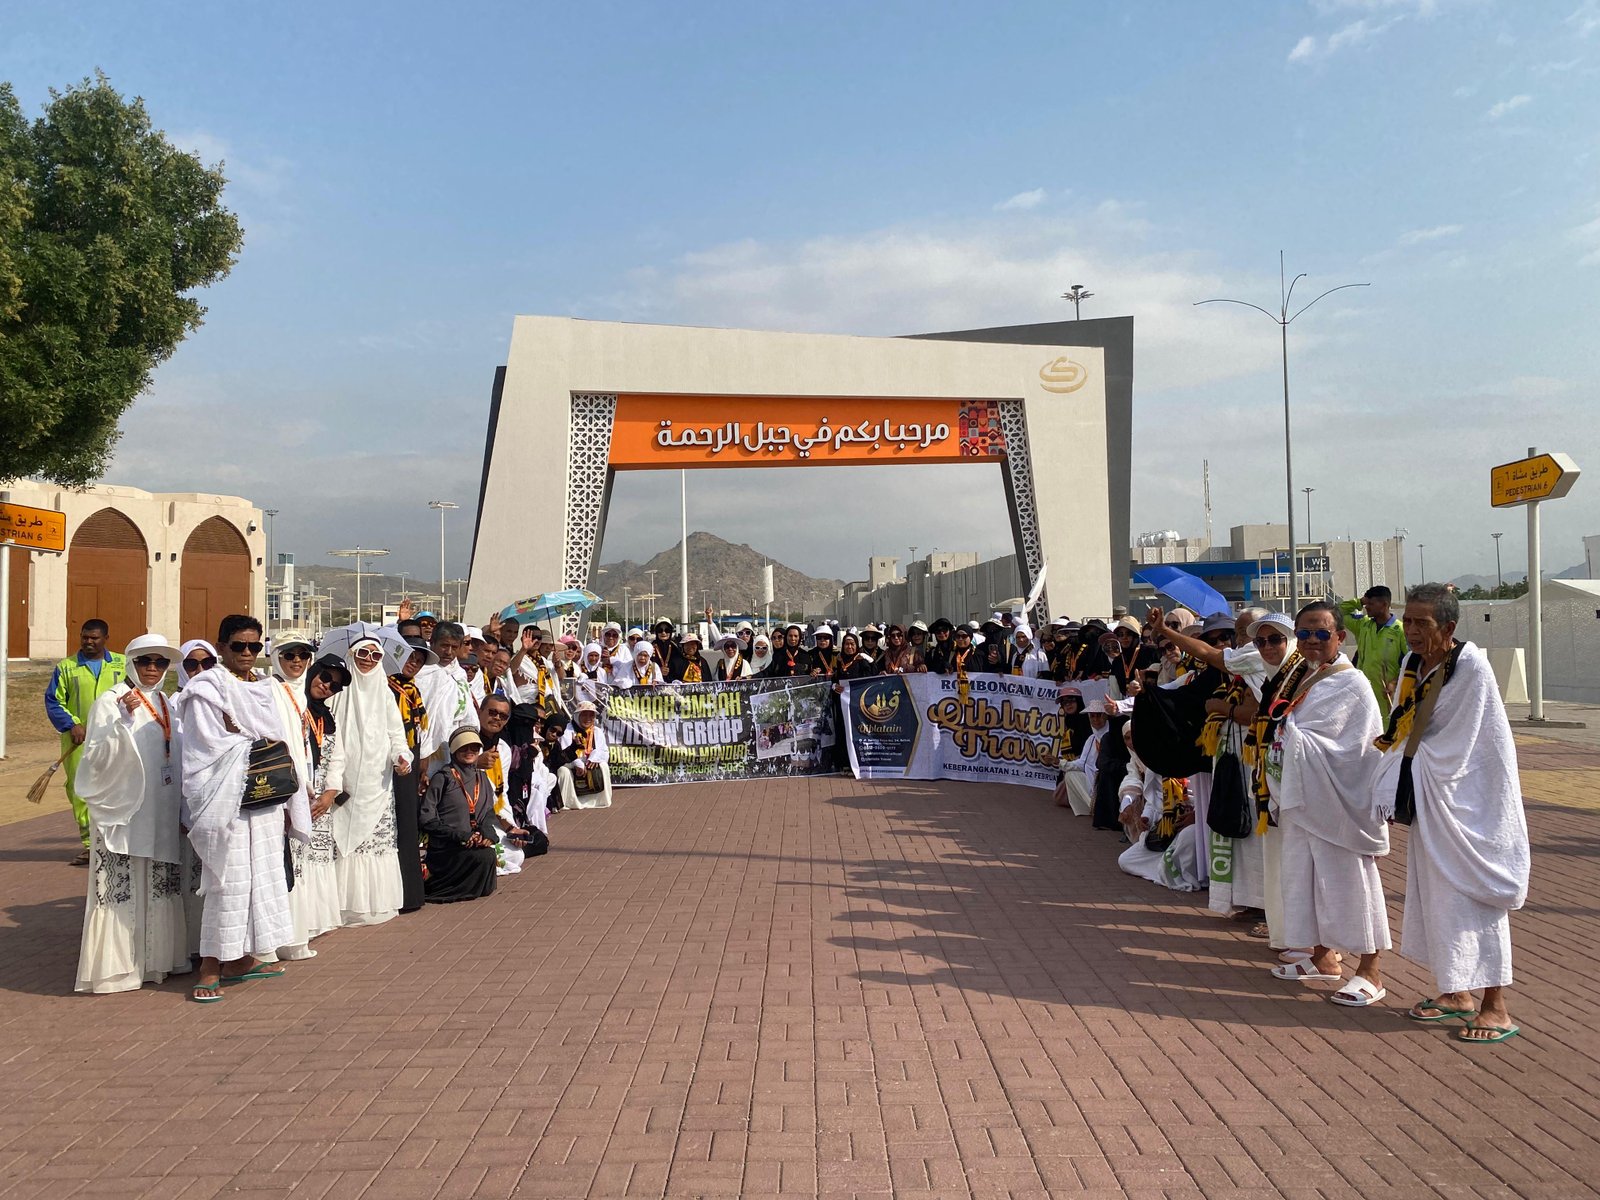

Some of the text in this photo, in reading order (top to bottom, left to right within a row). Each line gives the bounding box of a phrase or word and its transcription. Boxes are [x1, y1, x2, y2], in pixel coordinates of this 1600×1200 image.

[657, 417, 950, 458] مرحبا بكم في جبل الرحمة
[1512, 468, 1528, 480] مشاة
[1530, 463, 1549, 480] طريق
[1505, 481, 1548, 497] PEDESTRIAN 6
[15, 514, 43, 527] طريق
[0, 528, 43, 541] STRIAN 6
[682, 719, 743, 746] GROUP
[943, 763, 1009, 775] KEBERANGKATAN
